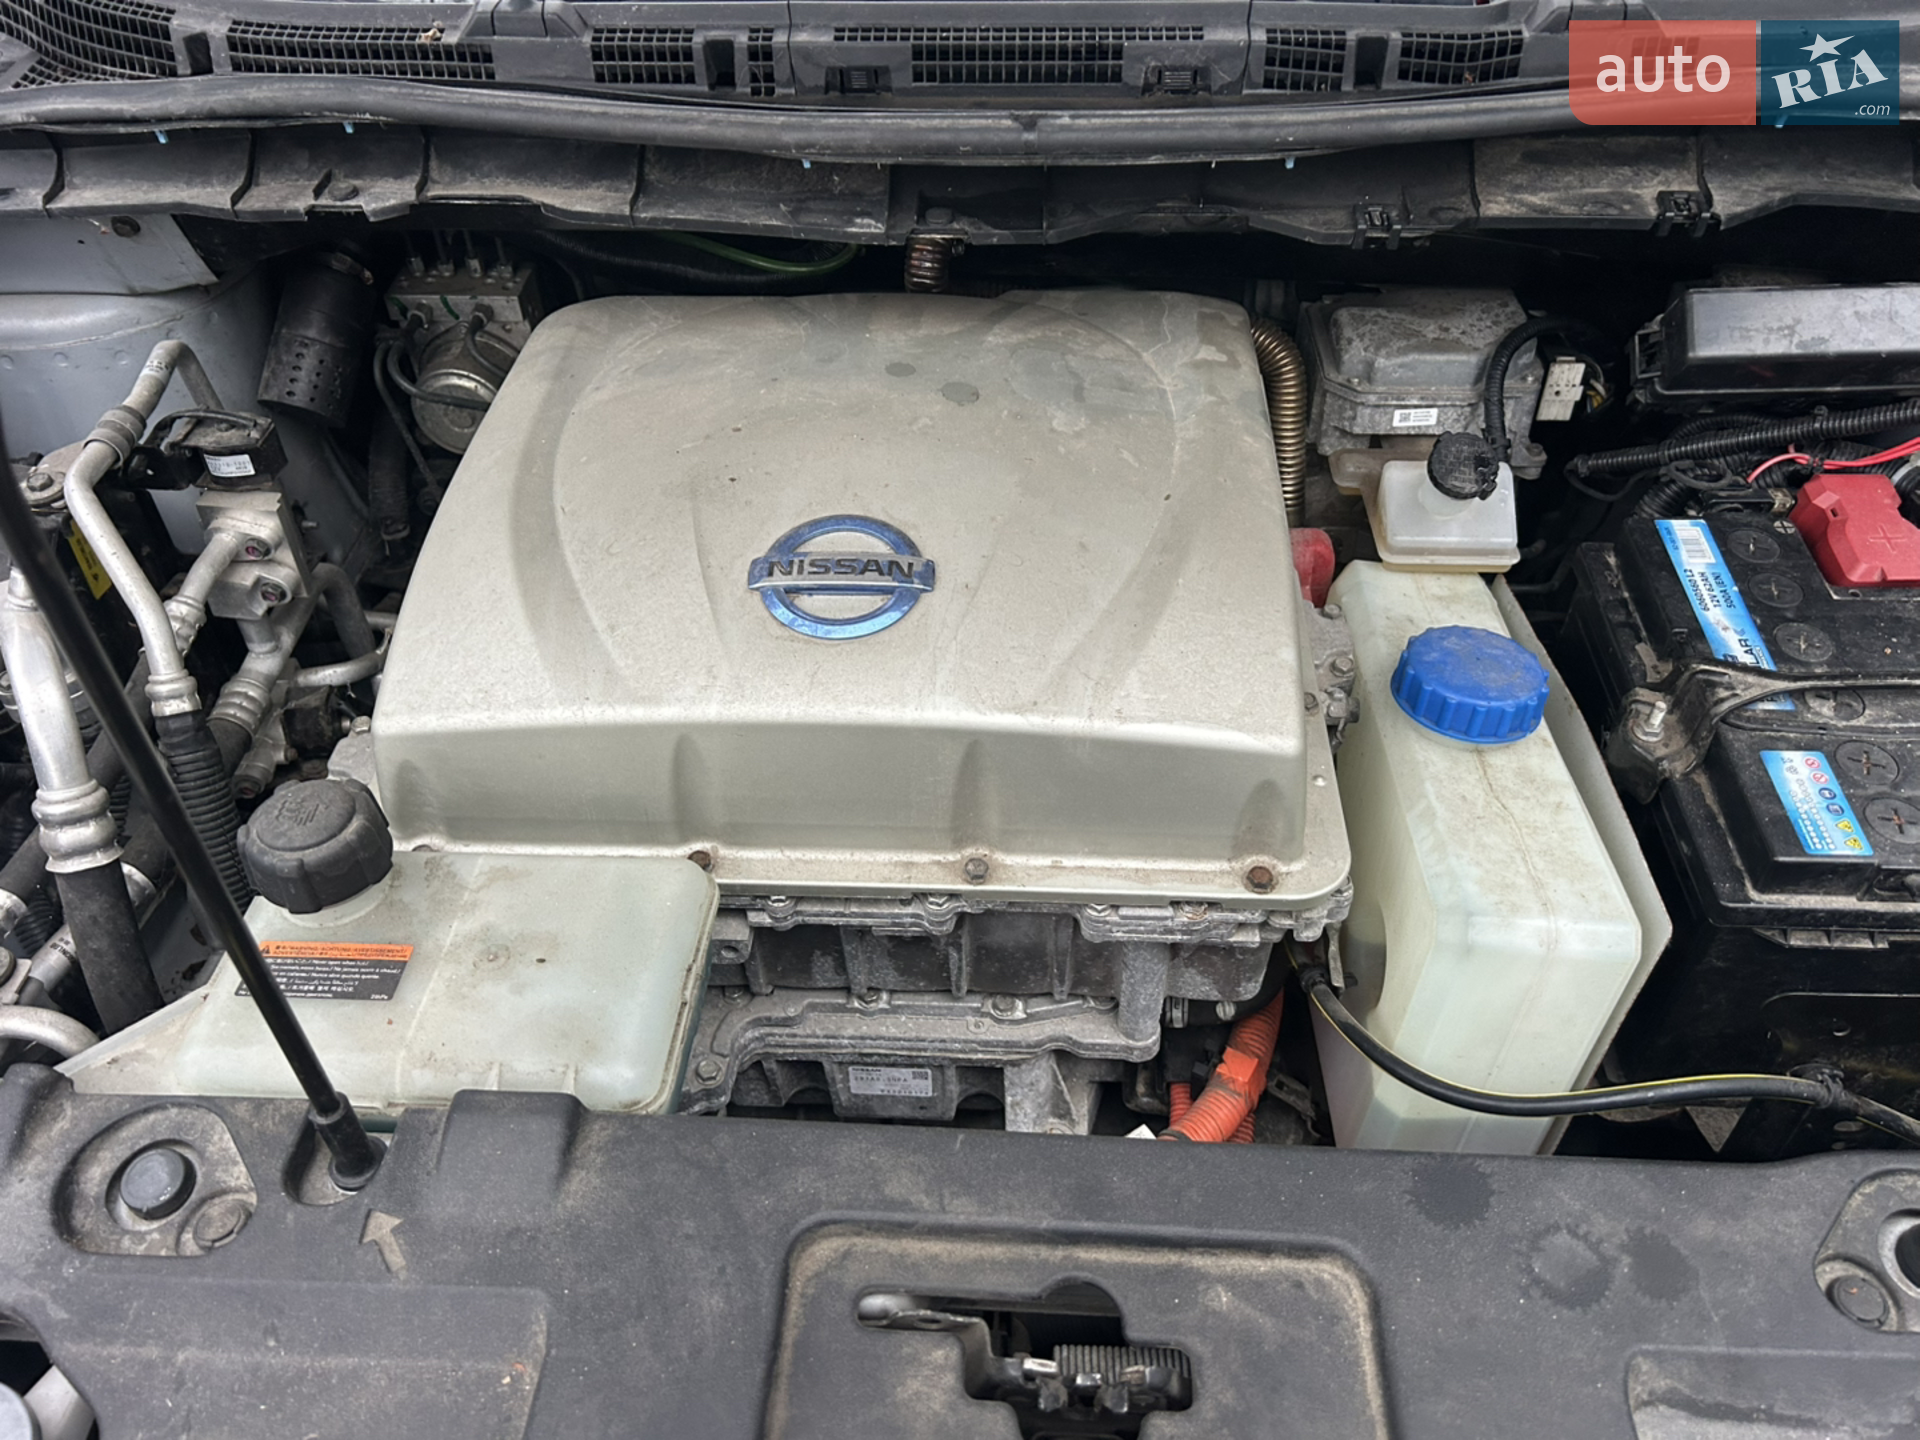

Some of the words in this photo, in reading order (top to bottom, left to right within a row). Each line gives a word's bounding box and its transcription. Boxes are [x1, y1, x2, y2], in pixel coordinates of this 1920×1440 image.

[767, 558, 914, 579] NISSAN
[1707, 593, 1722, 608] 12V
[1720, 588, 1736, 609] 500A
